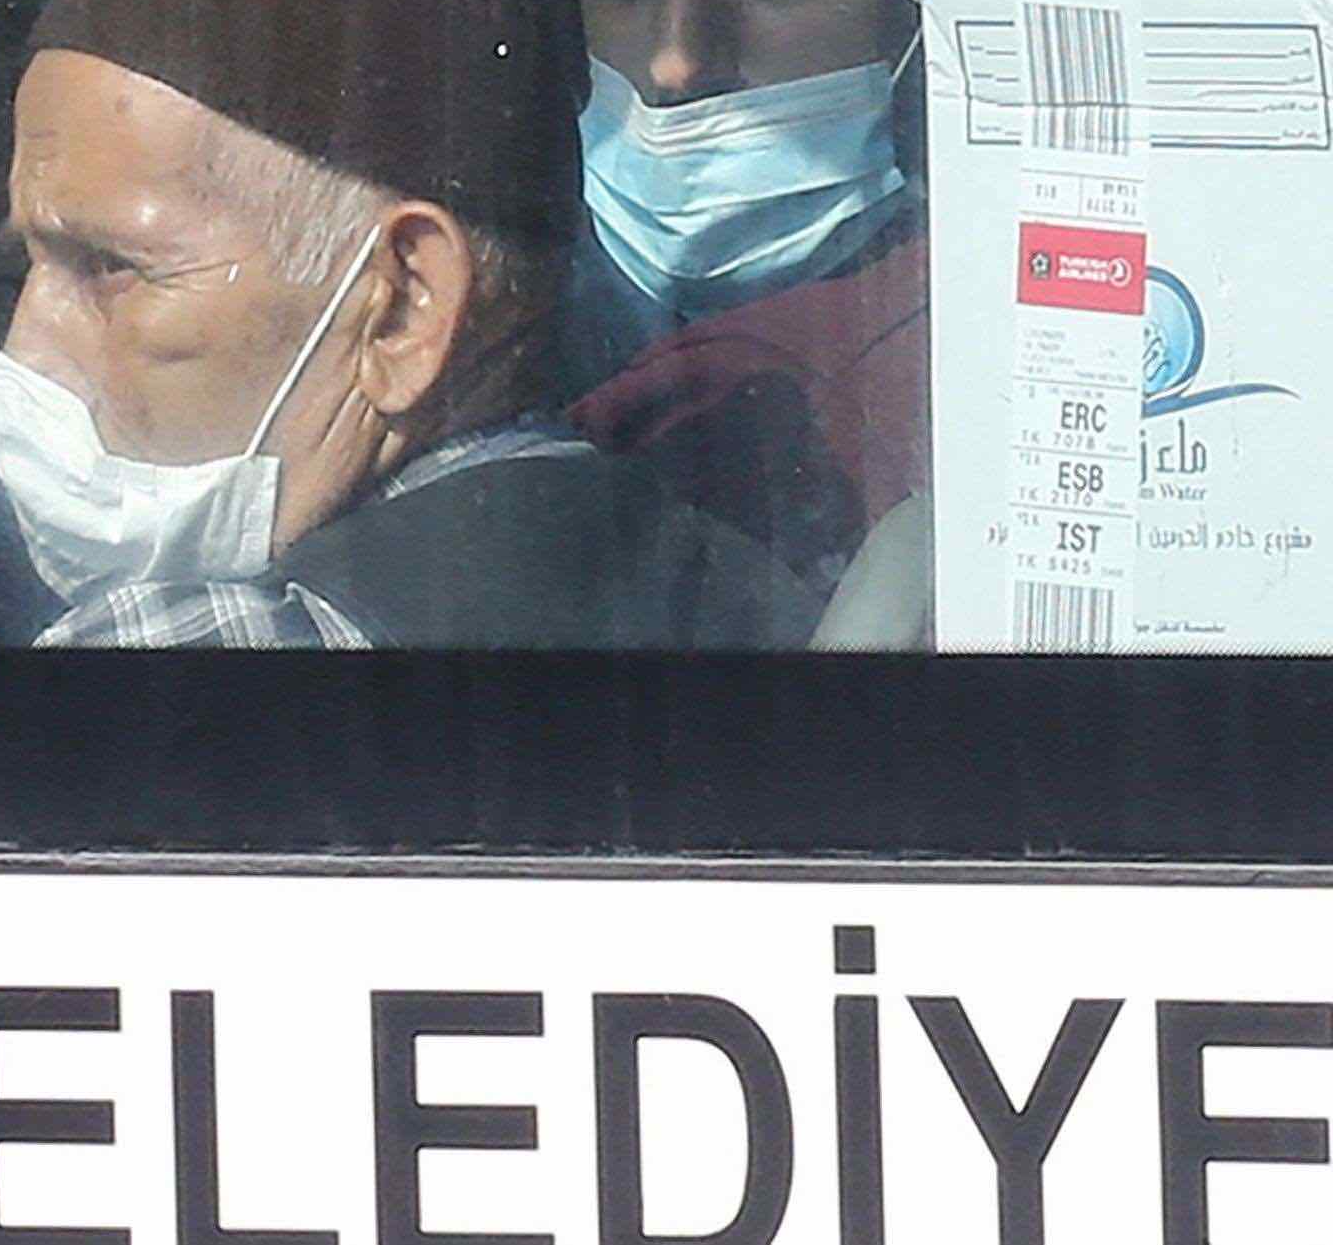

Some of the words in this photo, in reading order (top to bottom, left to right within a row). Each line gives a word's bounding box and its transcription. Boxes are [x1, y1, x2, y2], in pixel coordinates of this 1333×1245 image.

[1060, 401, 1108, 432] ERC
[1058, 460, 1104, 492] ESB
[1159, 484, 1206, 500] Water
[1057, 521, 1102, 554] IST
